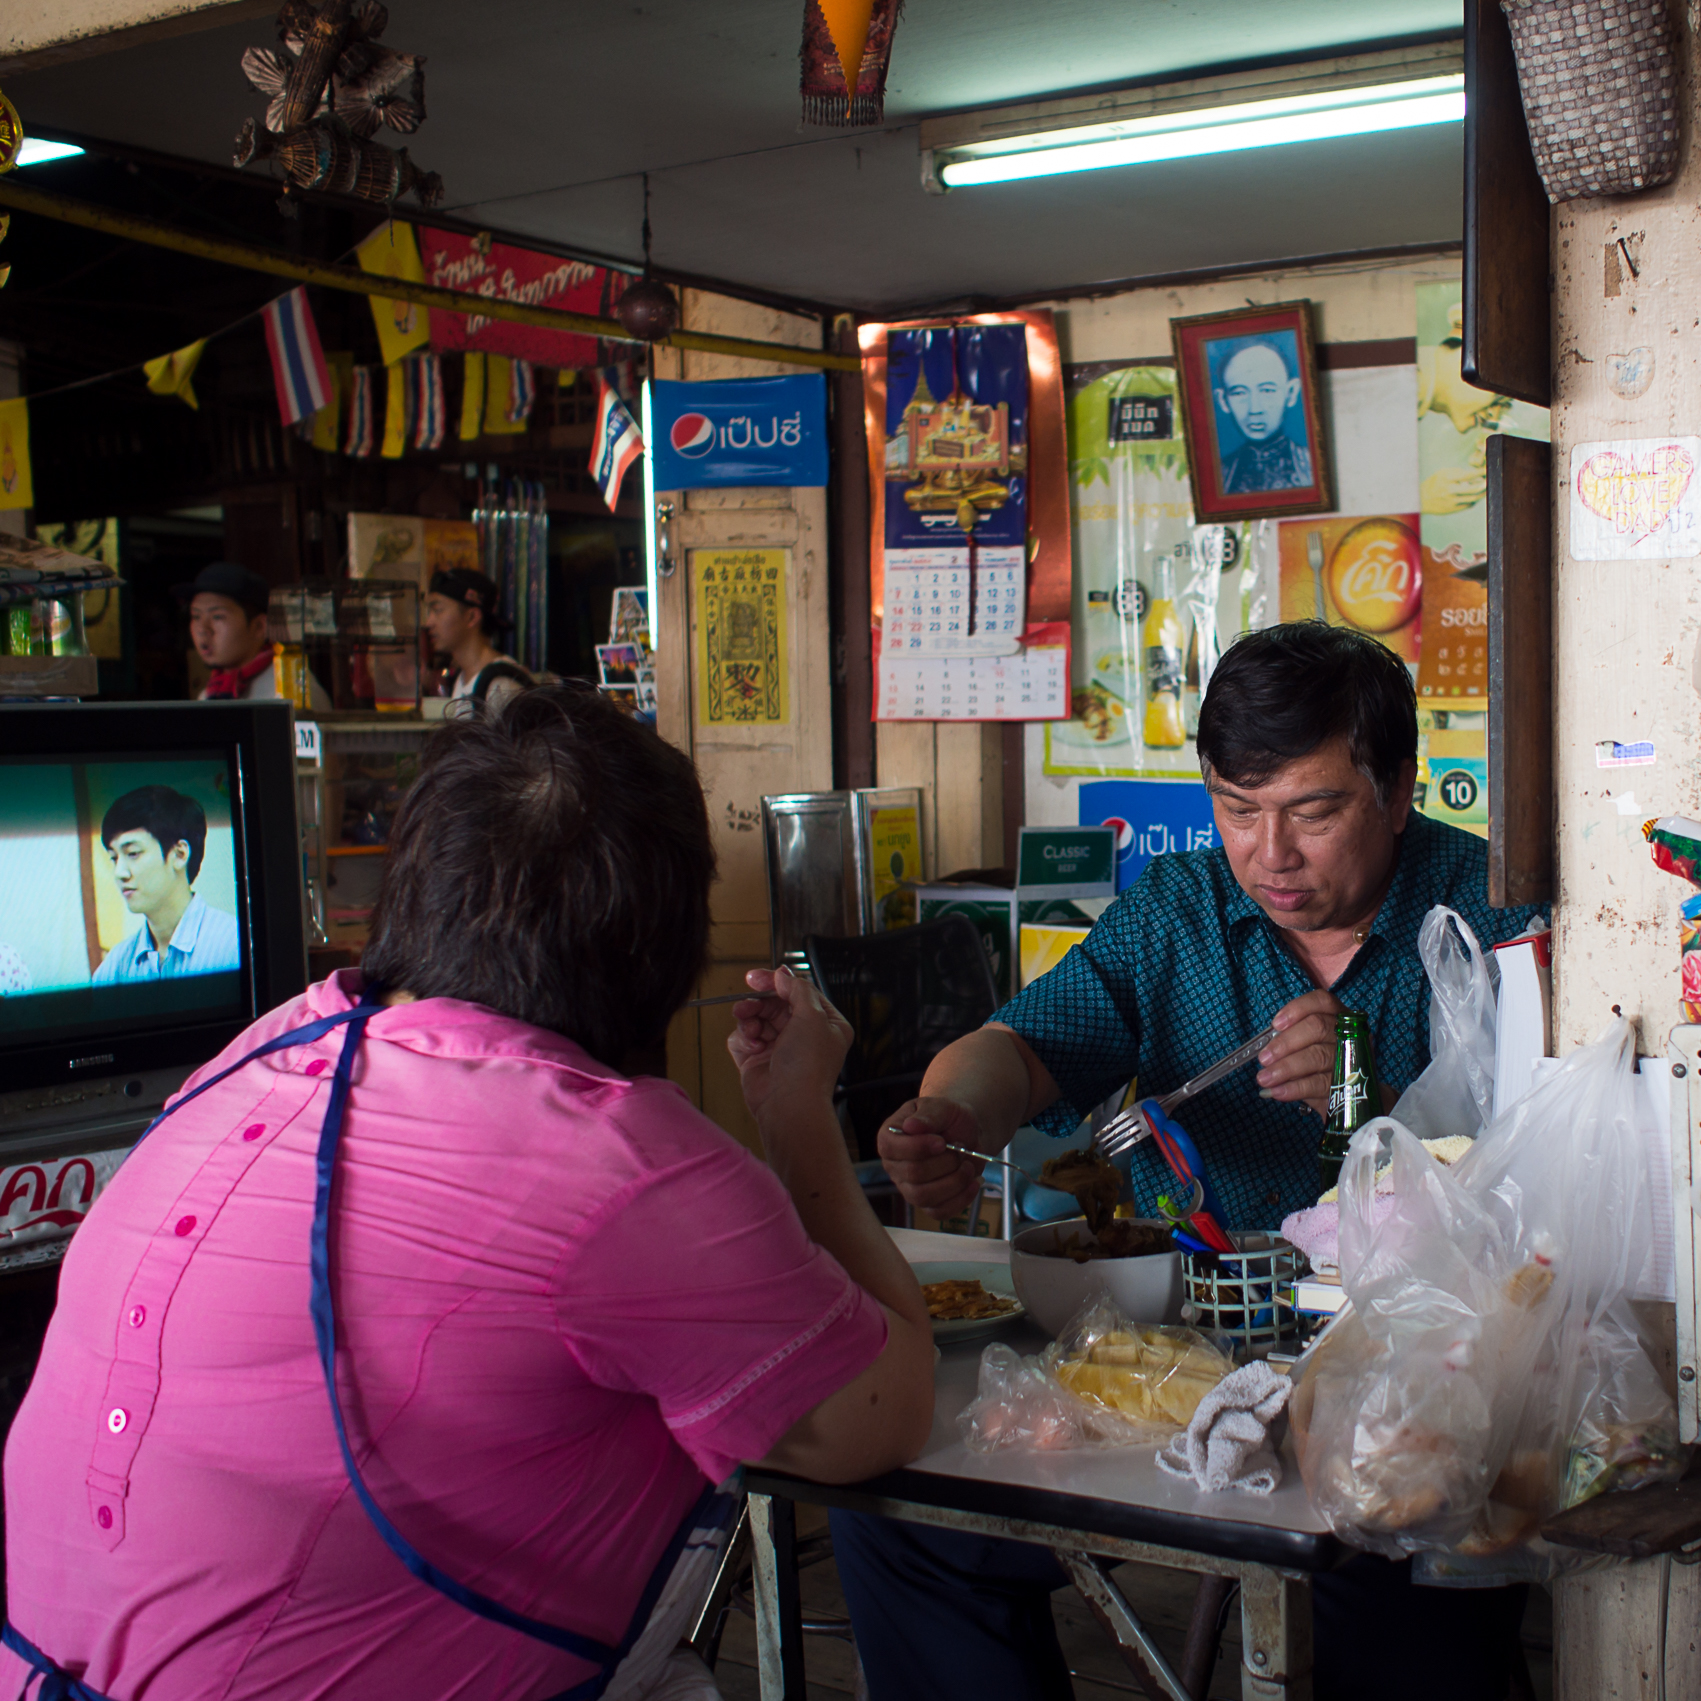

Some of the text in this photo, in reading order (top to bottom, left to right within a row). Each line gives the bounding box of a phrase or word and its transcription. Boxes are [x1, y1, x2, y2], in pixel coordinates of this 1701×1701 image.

[720, 411, 801, 449] เป๊ปซี่
[1590, 449, 1692, 479] GAMERS
[1612, 480, 1669, 506] LOVE
[1616, 509, 1665, 534] DAD
[914, 571, 1014, 584] 1 2 3 5 6
[895, 589, 902, 600] 7
[913, 590, 920, 600] 8
[932, 589, 939, 599] 9
[950, 589, 961, 599] 10
[987, 588, 999, 598] 12
[1005, 587, 1016, 598] 13
[892, 606, 904, 616] 14
[911, 605, 923, 616] 15
[930, 605, 942, 616] 16
[949, 605, 960, 615] 17
[986, 604, 998, 614] 19
[1004, 604, 1016, 614] 20
[891, 620, 1015, 632] 21 22 23 24 26 27
[890, 638, 903, 649] 28
[909, 637, 922, 648] 29
[917, 671, 923, 679] 7
[1048, 668, 1057, 676] 12
[915, 684, 925, 692] 14
[968, 683, 978, 691] 16
[995, 682, 1005, 690] 17
[915, 697, 924, 705] 21
[941, 696, 951, 704] 22
[968, 696, 978, 704] 23
[995, 695, 1005, 703] 24
[1021, 694, 1031, 702] 25
[941, 708, 951, 716] 29
[968, 708, 978, 716] 30
[1445, 780, 1472, 804] 10
[1043, 845, 1091, 859] CLASSIC
[1057, 862, 1077, 873] BEER
[69, 1053, 114, 1069] SAMSUNG
